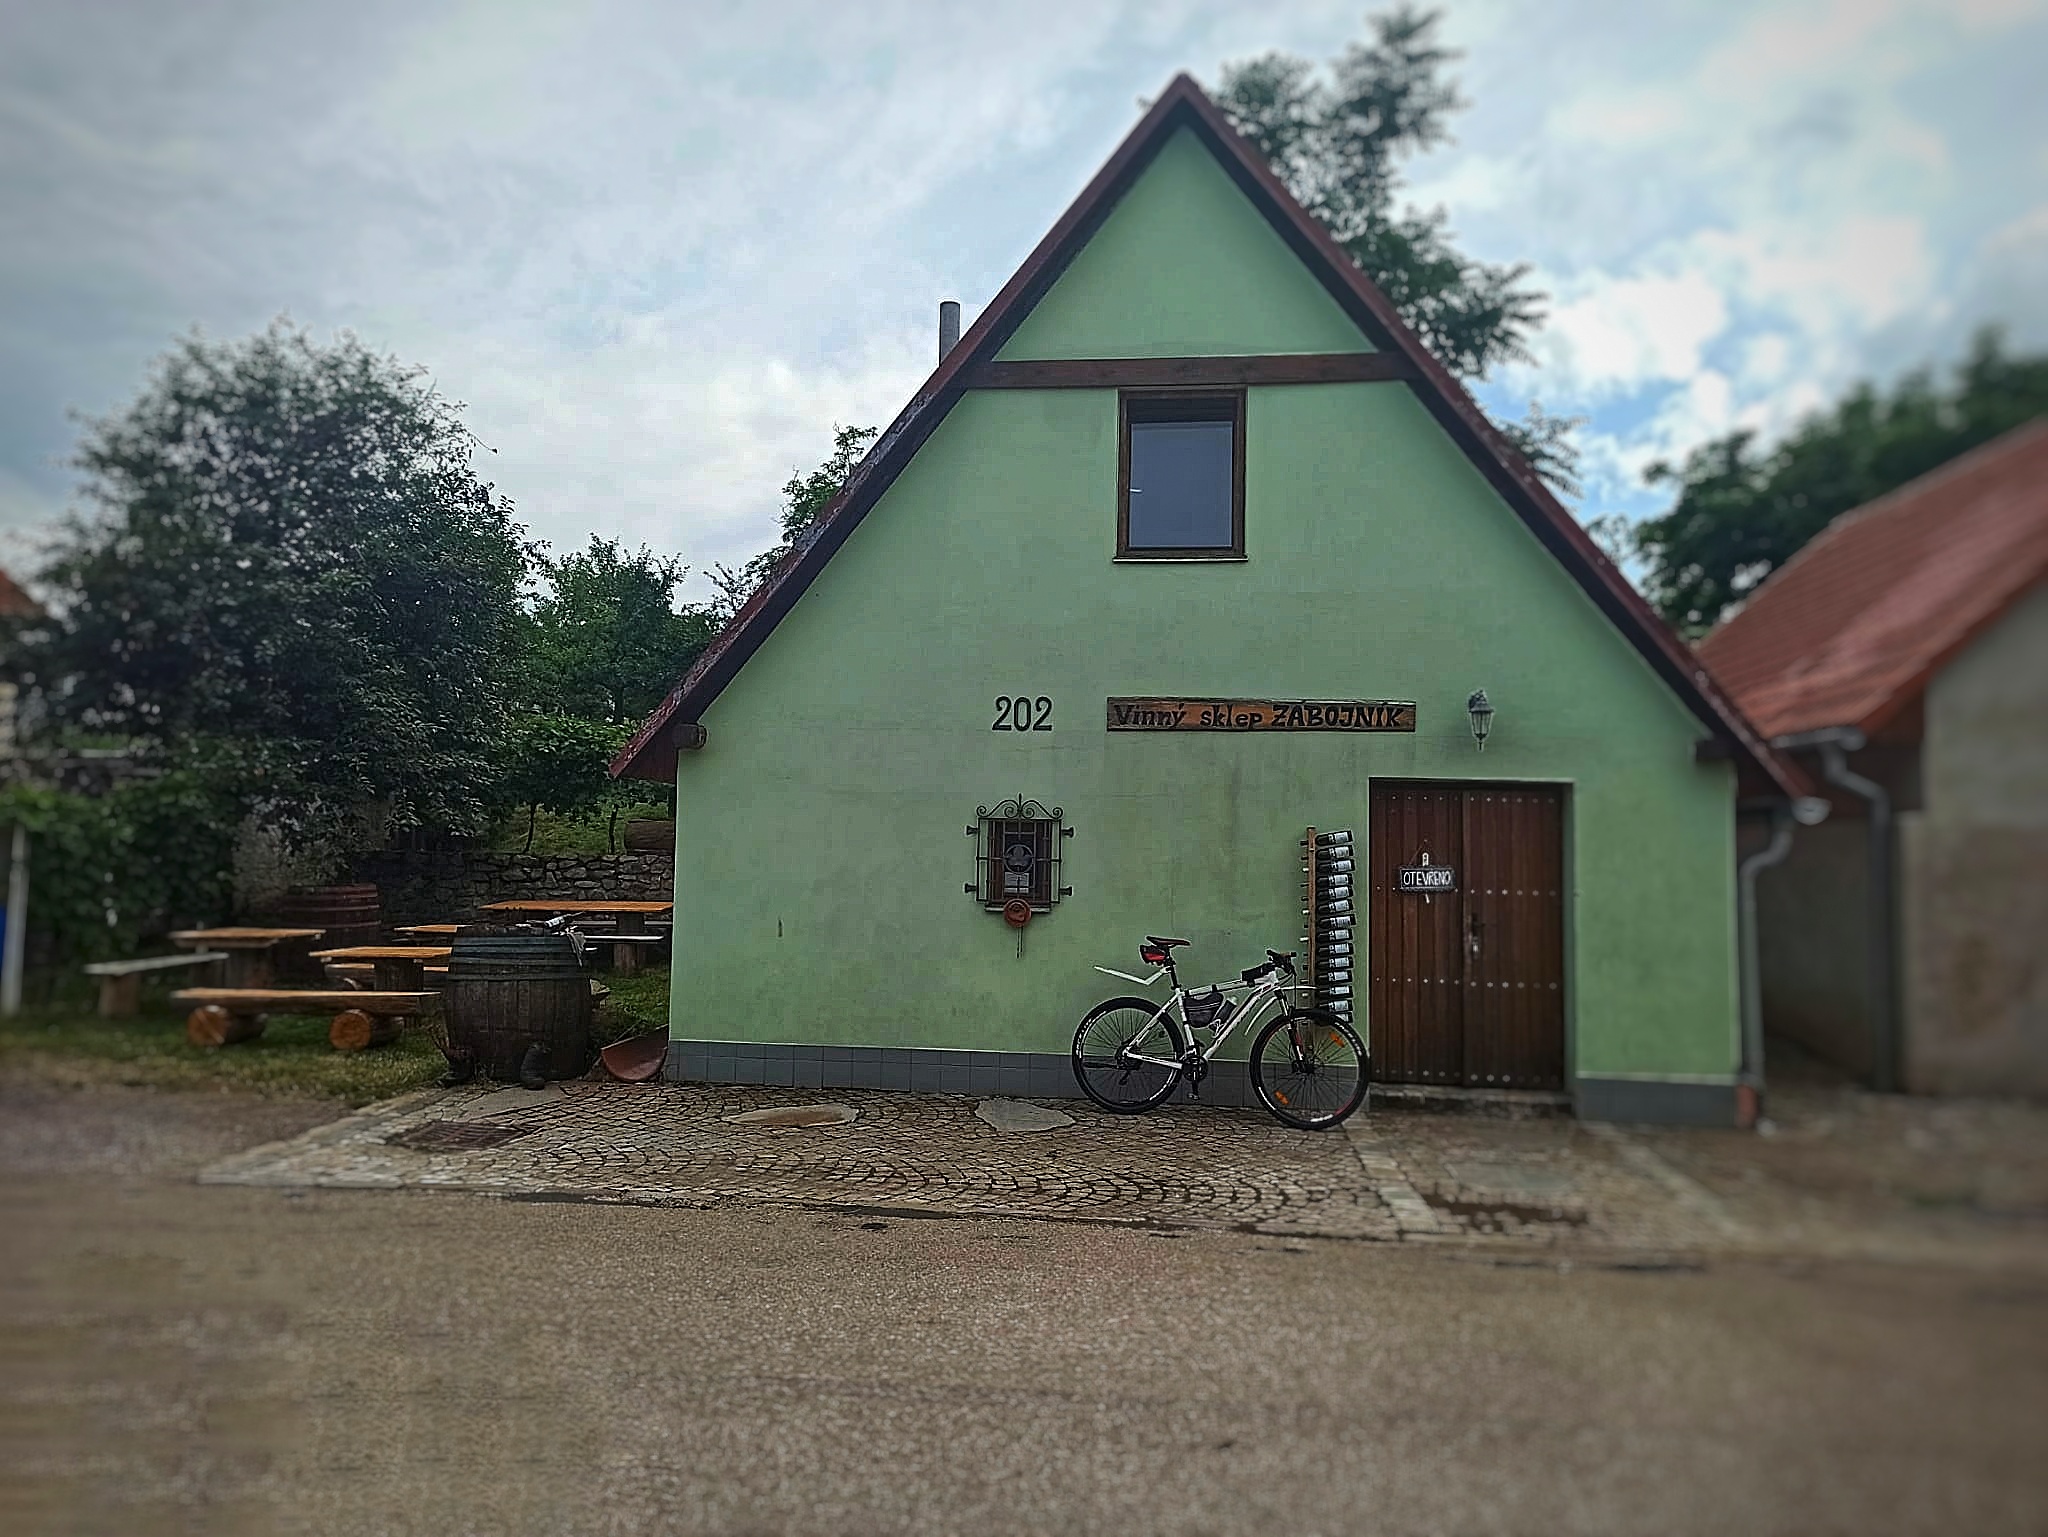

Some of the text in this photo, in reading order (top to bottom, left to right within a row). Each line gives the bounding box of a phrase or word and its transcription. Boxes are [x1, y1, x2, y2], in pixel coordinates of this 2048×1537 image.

[991, 695, 1053, 732] 202
[1114, 703, 1186, 728] Vinný
[1200, 703, 1263, 728] sklep
